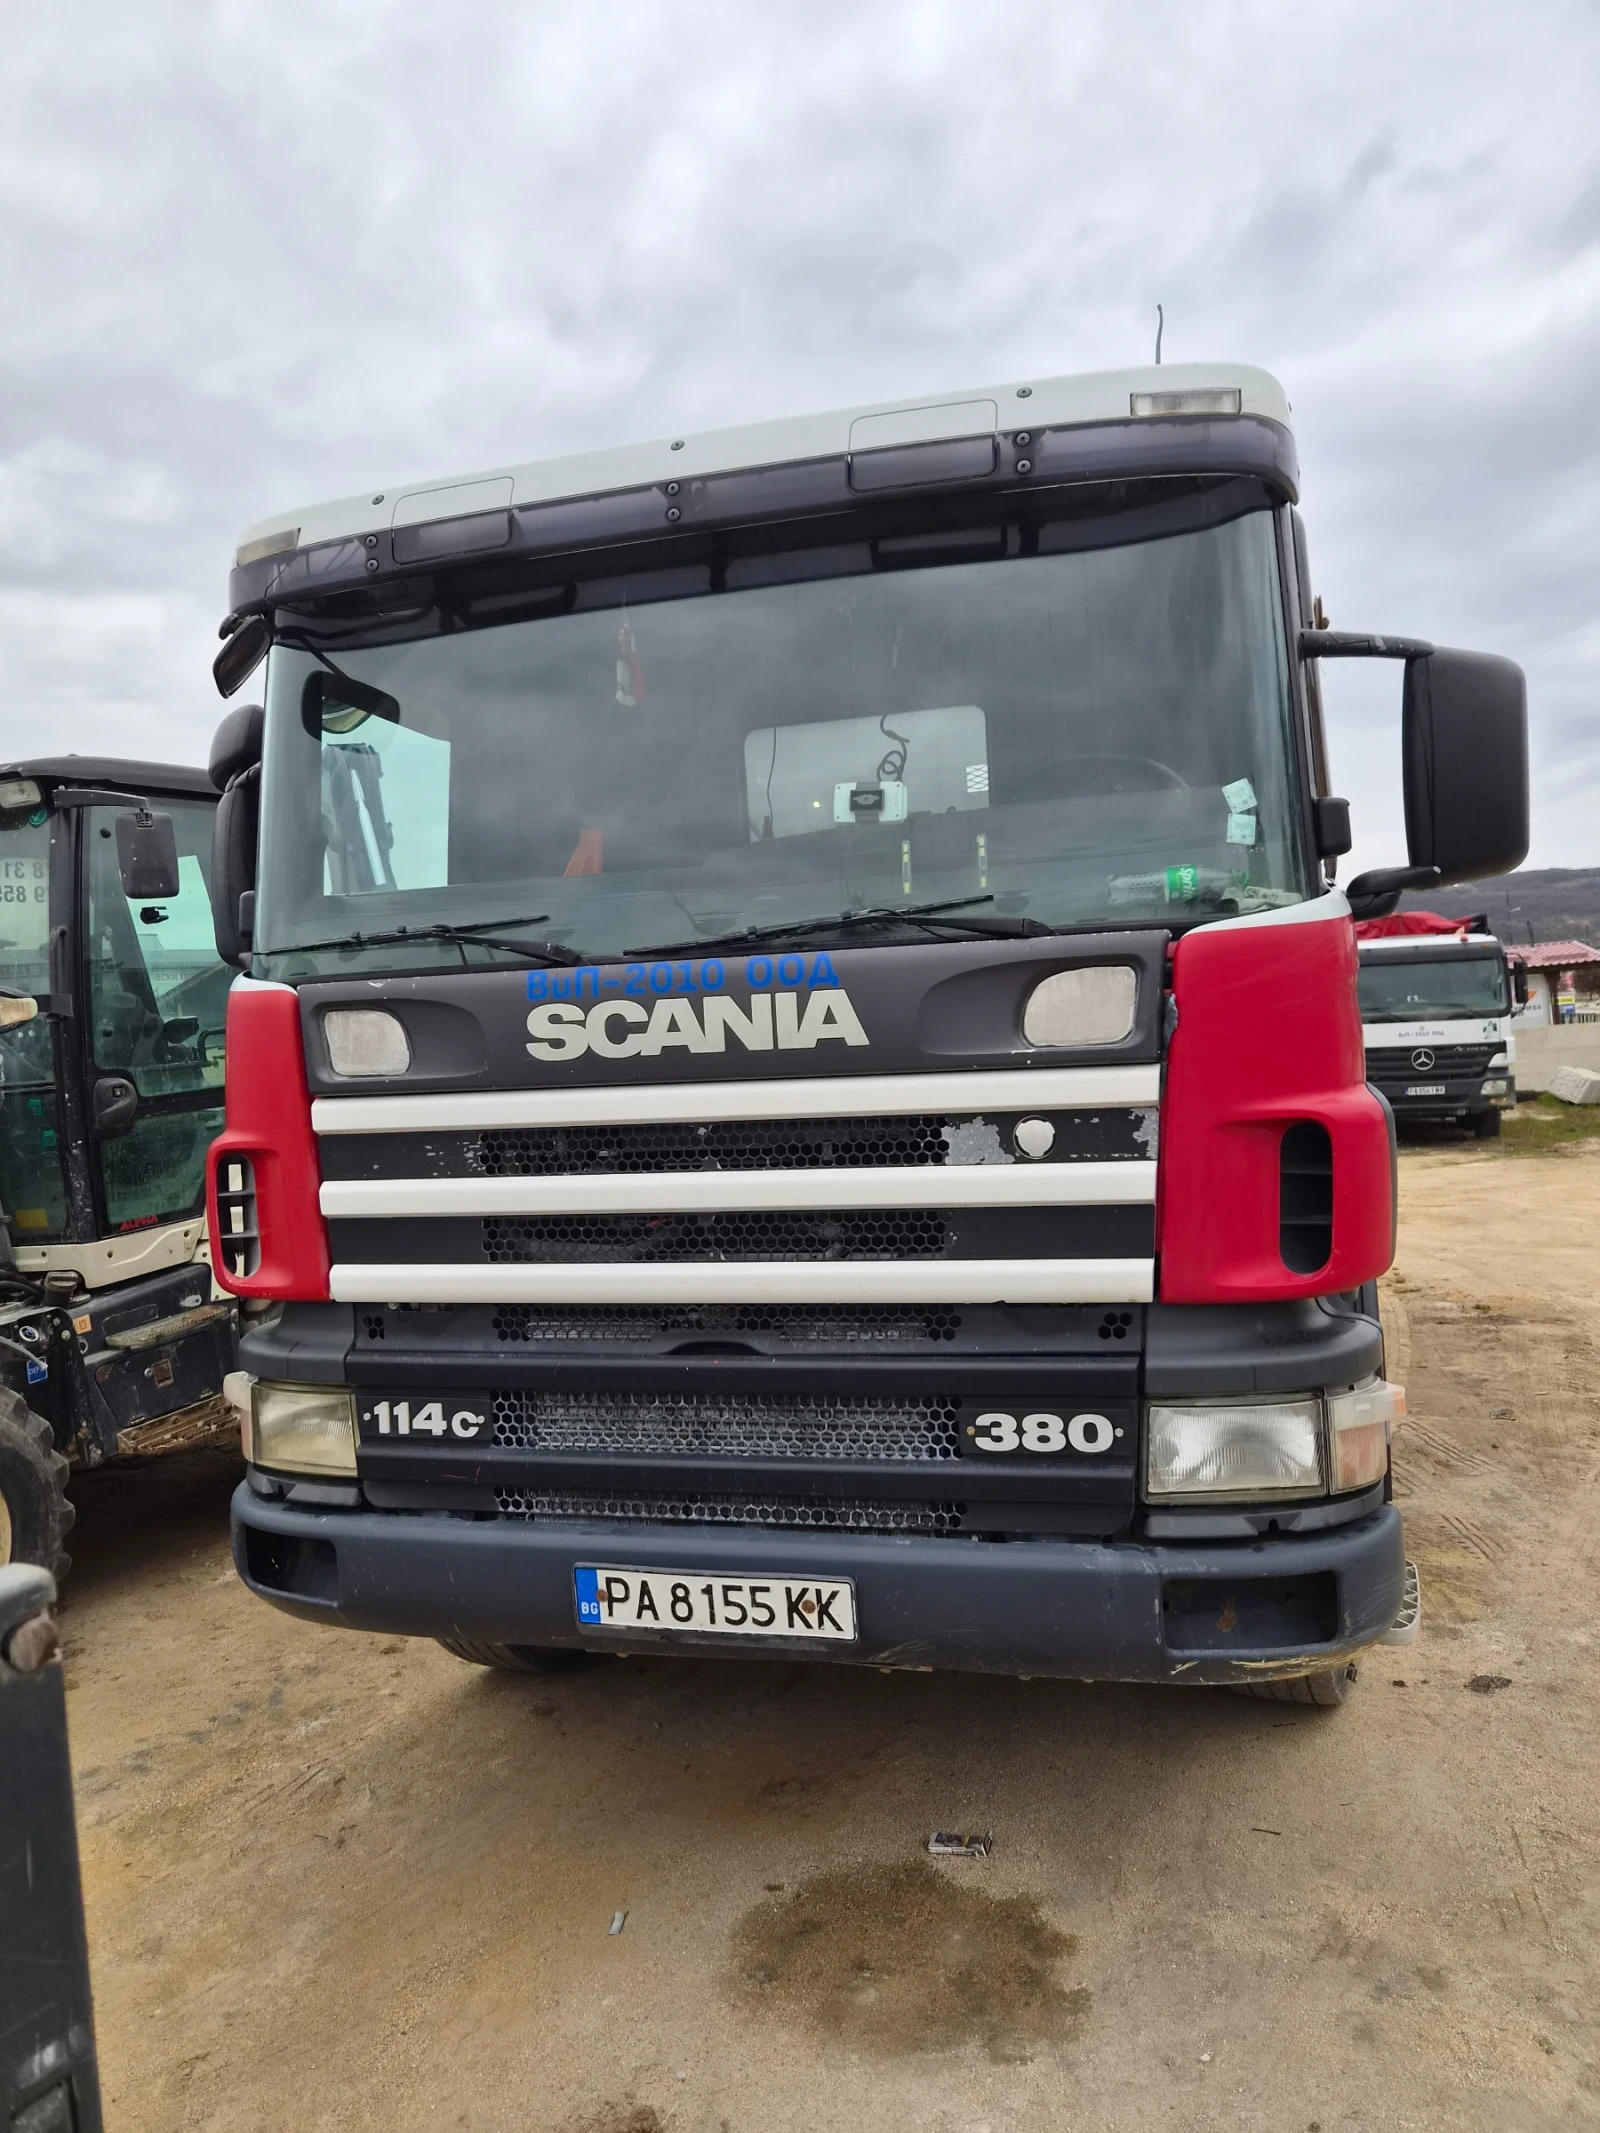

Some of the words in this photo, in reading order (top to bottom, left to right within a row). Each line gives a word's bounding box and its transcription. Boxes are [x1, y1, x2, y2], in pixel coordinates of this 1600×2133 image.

[526, 958, 725, 1001] ВиП-2010
[746, 952, 840, 988] ООД
[526, 988, 870, 1062] SCANIA
[119, 1214, 158, 1232] ALPHA
[975, 1413, 1114, 1453] 380
[581, 1602, 599, 1615] BG
